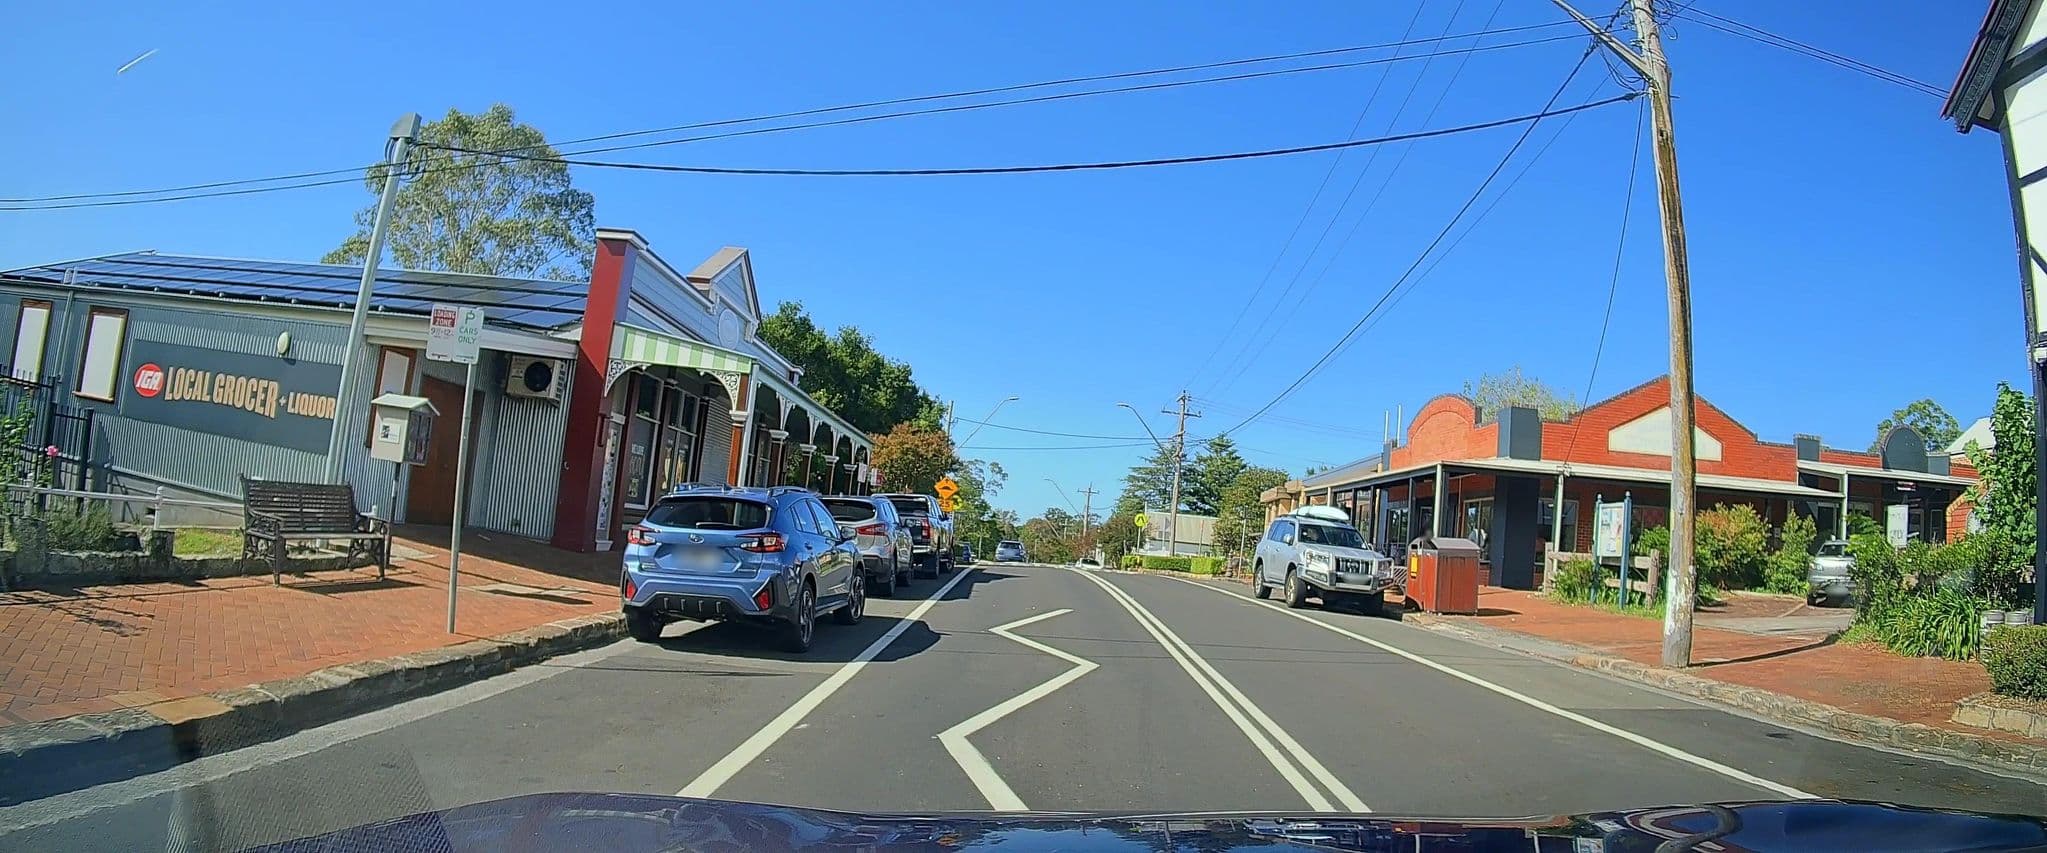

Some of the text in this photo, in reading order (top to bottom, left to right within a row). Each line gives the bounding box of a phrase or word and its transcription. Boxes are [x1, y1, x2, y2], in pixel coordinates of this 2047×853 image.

[435, 310, 456, 319] LOADING
[464, 311, 475, 324] P
[435, 318, 453, 327] ZONE
[459, 326, 479, 336] CARS
[458, 335, 477, 344] ONLY
[135, 370, 164, 391] IGA
[164, 366, 211, 402] LOCAL
[212, 373, 279, 418] GROCER
[286, 391, 336, 419] LIQUOR
[939, 499, 951, 508] 25
